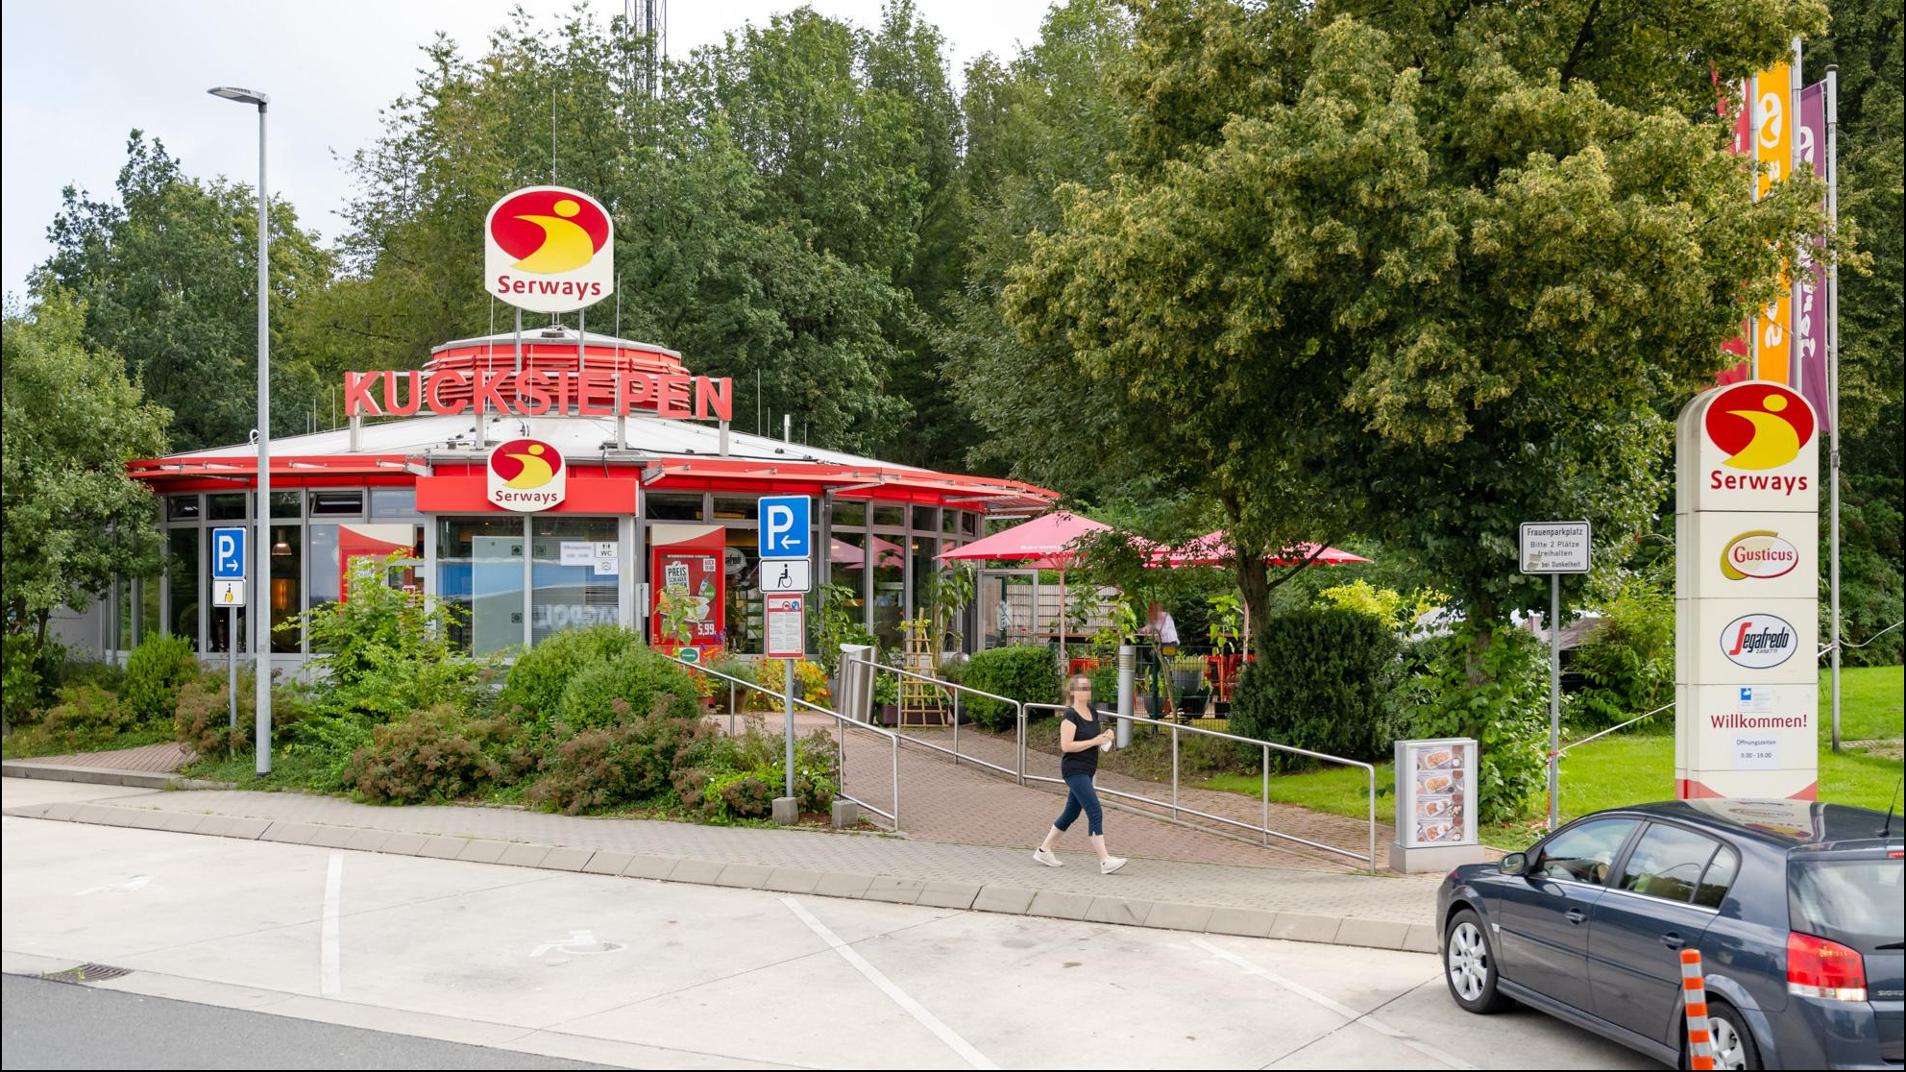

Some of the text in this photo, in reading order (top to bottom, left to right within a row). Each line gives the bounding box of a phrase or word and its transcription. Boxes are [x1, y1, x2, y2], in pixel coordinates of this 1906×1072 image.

[498, 275, 601, 300] Serways
[345, 370, 733, 421] KUCKSIEPEN
[1711, 470, 1808, 495] Serways
[495, 490, 558, 506] Serways
[767, 504, 794, 550] P
[1527, 528, 1583, 537] Frauenparkplatz
[218, 535, 235, 572] P
[1537, 549, 1573, 557] freihalten
[1734, 546, 1793, 563] Gusticus
[668, 567, 687, 577] PREIS
[1729, 621, 1789, 656] Segafredo
[1711, 714, 1808, 728] Willkommen!
